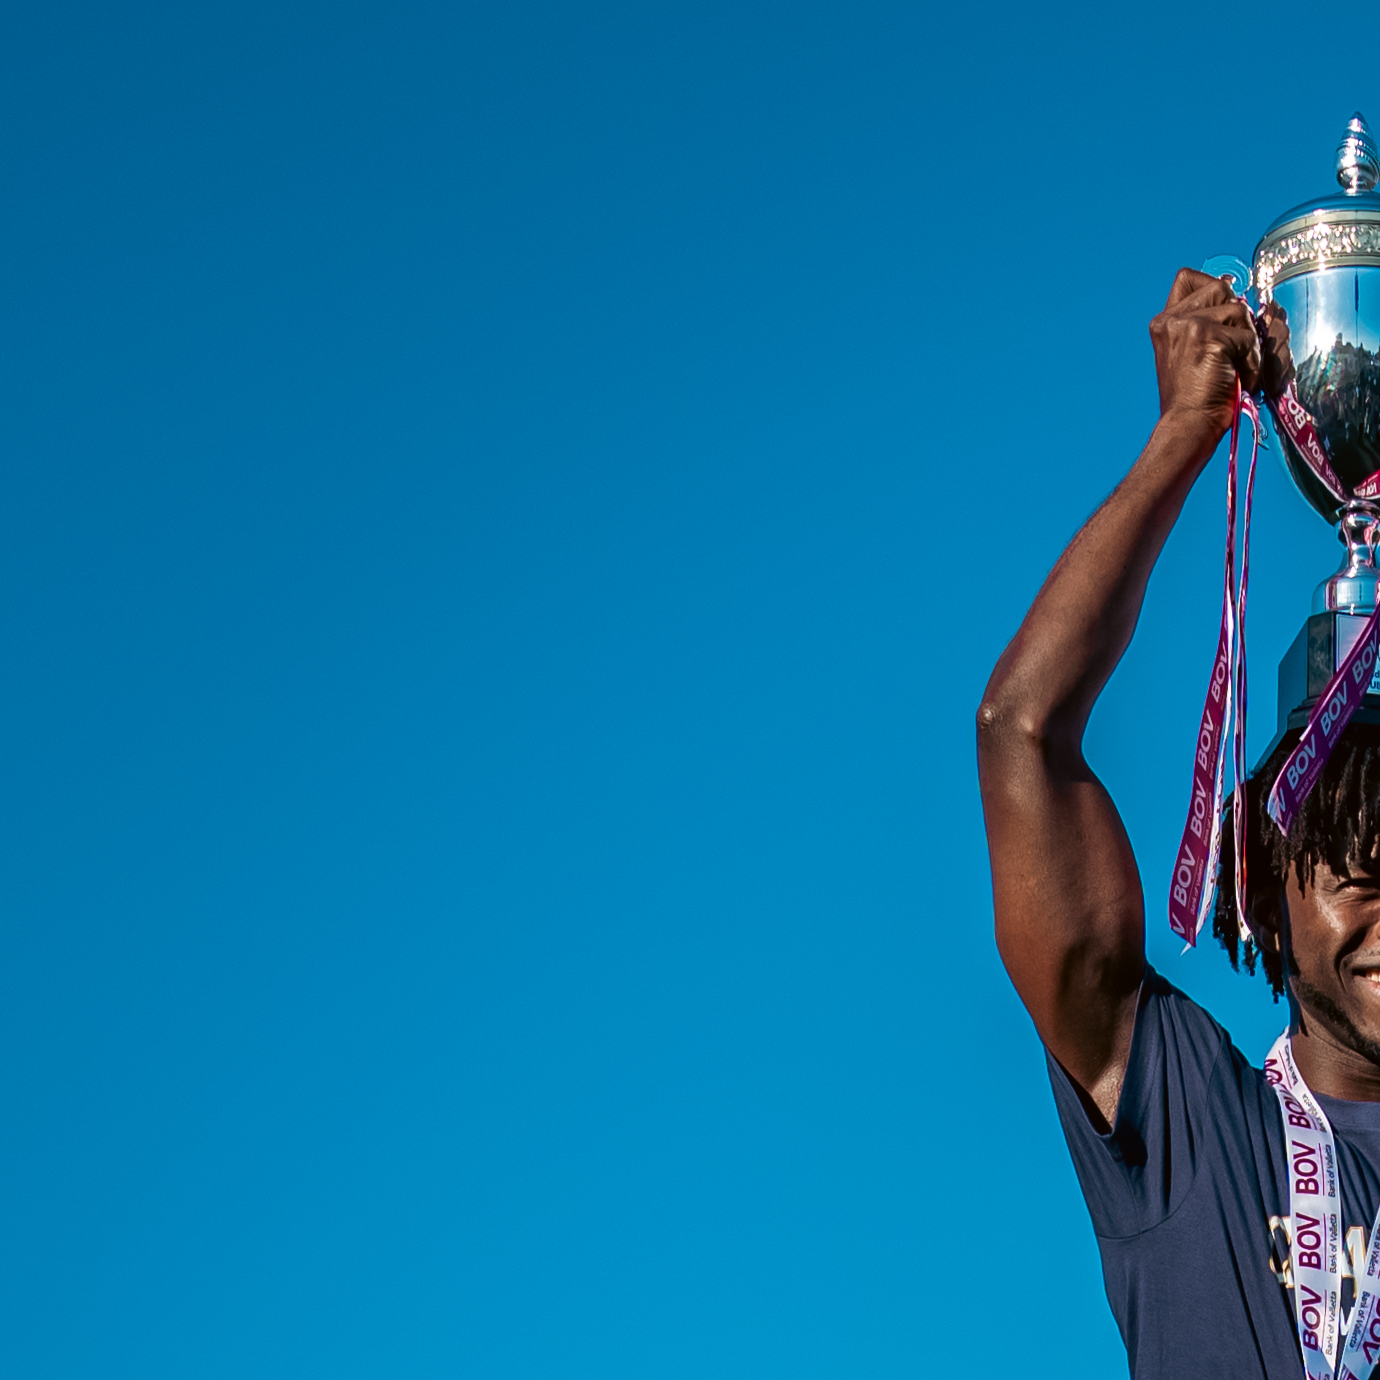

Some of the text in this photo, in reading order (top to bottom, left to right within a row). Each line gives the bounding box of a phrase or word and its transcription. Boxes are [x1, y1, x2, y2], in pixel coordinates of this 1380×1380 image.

[1211, 642, 1227, 702] BOV
[1352, 628, 1377, 684] BOV
[1320, 680, 1349, 737] BOV
[1197, 709, 1214, 771] BOV
[1286, 734, 1316, 790] BOV
[1190, 777, 1206, 839] BOV
[1173, 844, 1196, 908] BOV
[1291, 1140, 1319, 1196] BOV
[1296, 1212, 1321, 1270] BOV
[1300, 1284, 1322, 1351] BOV
[1327, 1321, 1335, 1335] of
[1326, 1338, 1334, 1355] Bank
